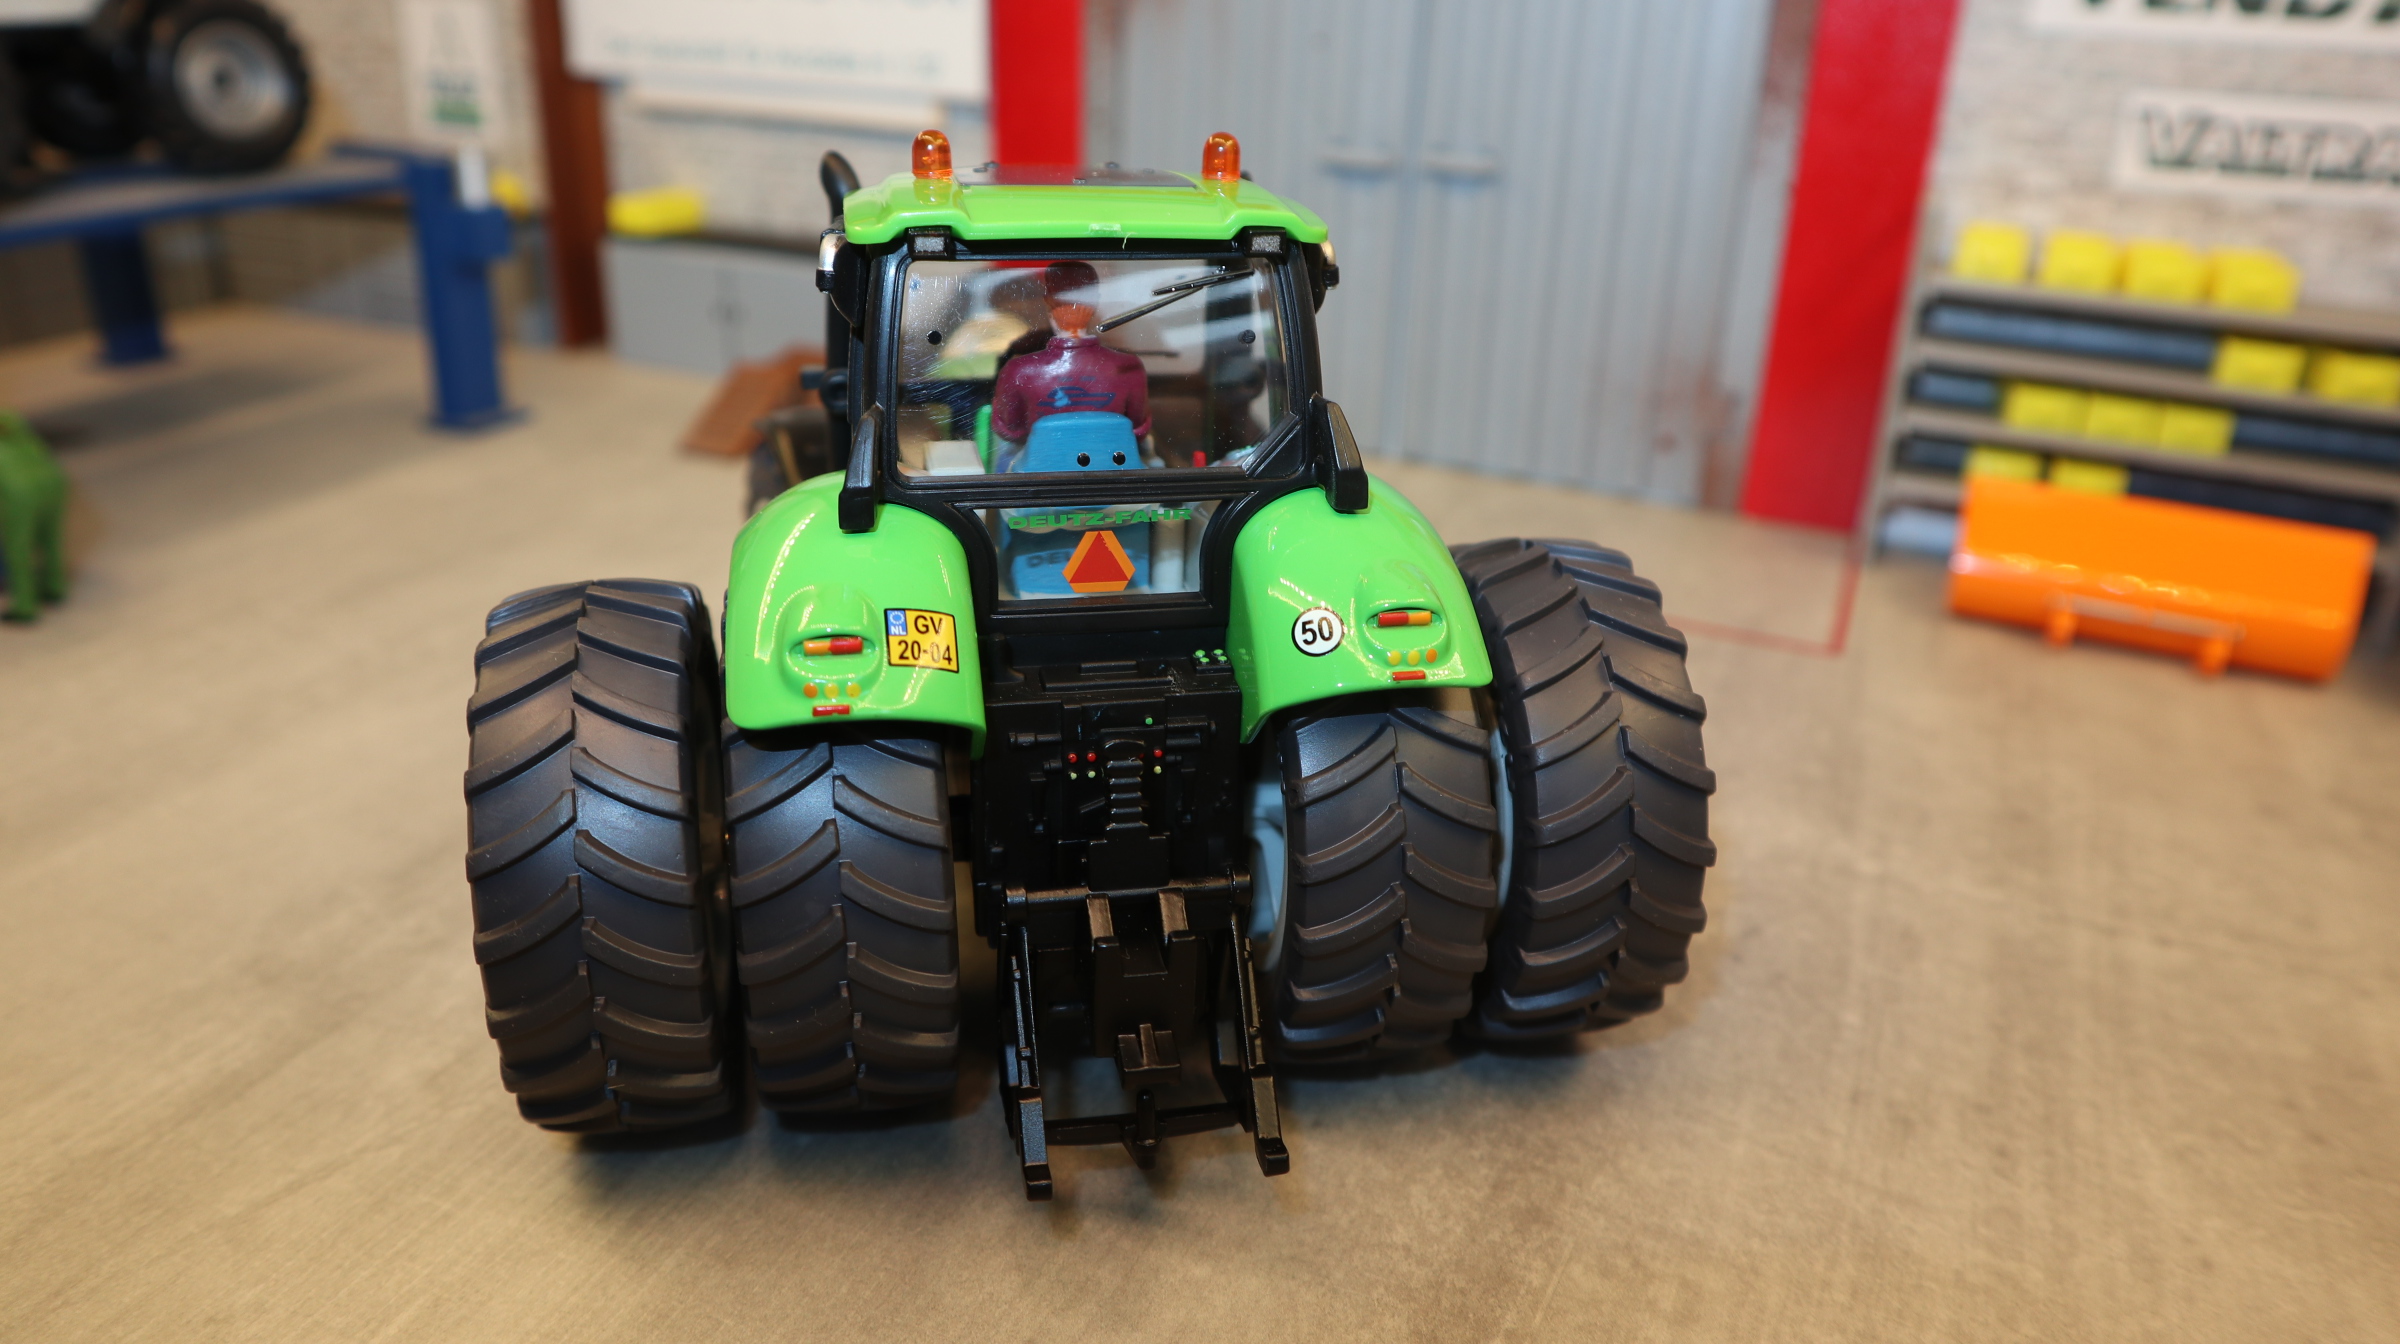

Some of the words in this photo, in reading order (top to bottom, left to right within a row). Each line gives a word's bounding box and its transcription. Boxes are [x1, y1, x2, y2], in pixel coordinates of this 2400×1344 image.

[1007, 508, 1193, 530] DEUTZ-FAHR
[890, 625, 907, 635] NL
[914, 614, 943, 635] GV
[1301, 615, 1334, 646] 50
[898, 639, 953, 666] 20-04
